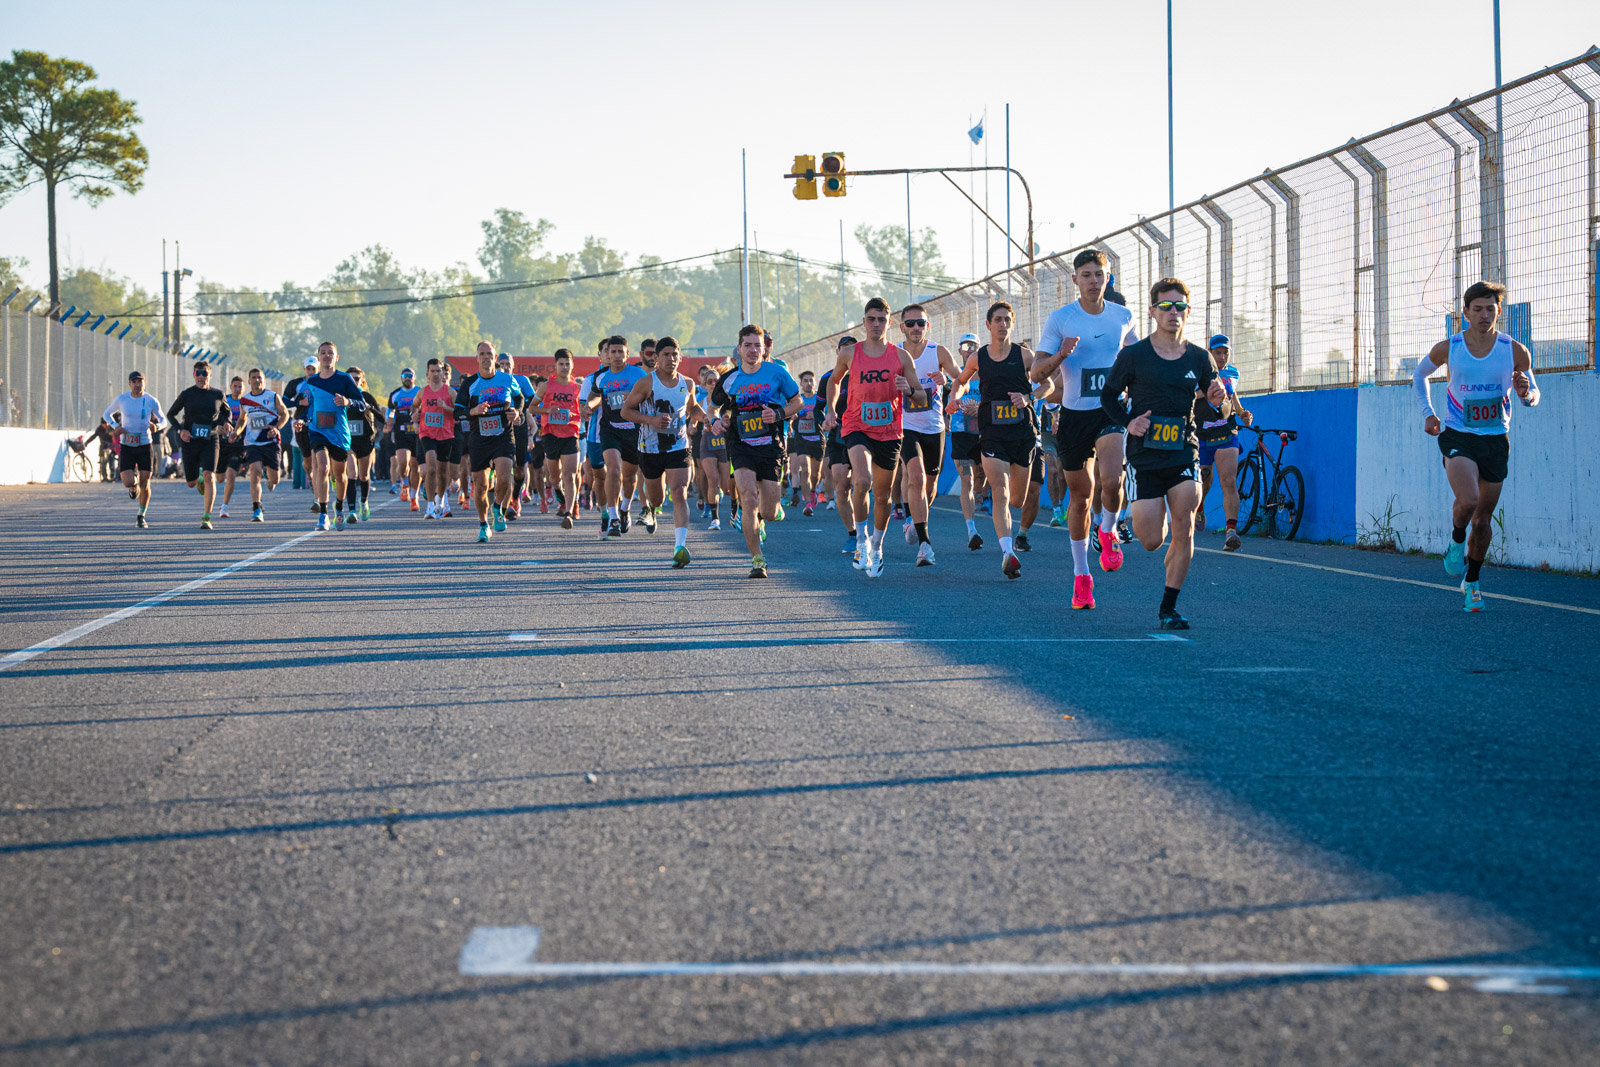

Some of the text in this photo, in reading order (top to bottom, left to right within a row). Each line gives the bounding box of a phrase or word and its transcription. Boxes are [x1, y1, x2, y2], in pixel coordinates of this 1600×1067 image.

[516, 364, 556, 374] IEMPO
[860, 369, 890, 384] KRC
[1090, 374, 1106, 391] 10
[1460, 384, 1503, 392] RUNNEA
[553, 393, 573, 402] KRC
[426, 399, 438, 407] KR
[867, 407, 887, 421] 313
[997, 405, 1018, 419] 718
[1472, 404, 1497, 421] 303
[252, 418, 265, 428] 144
[427, 415, 441, 425] 316
[483, 419, 499, 430] 359
[743, 417, 763, 433] 707
[195, 428, 208, 437] 167
[1153, 423, 1179, 442] 706
[711, 437, 725, 447] 616
